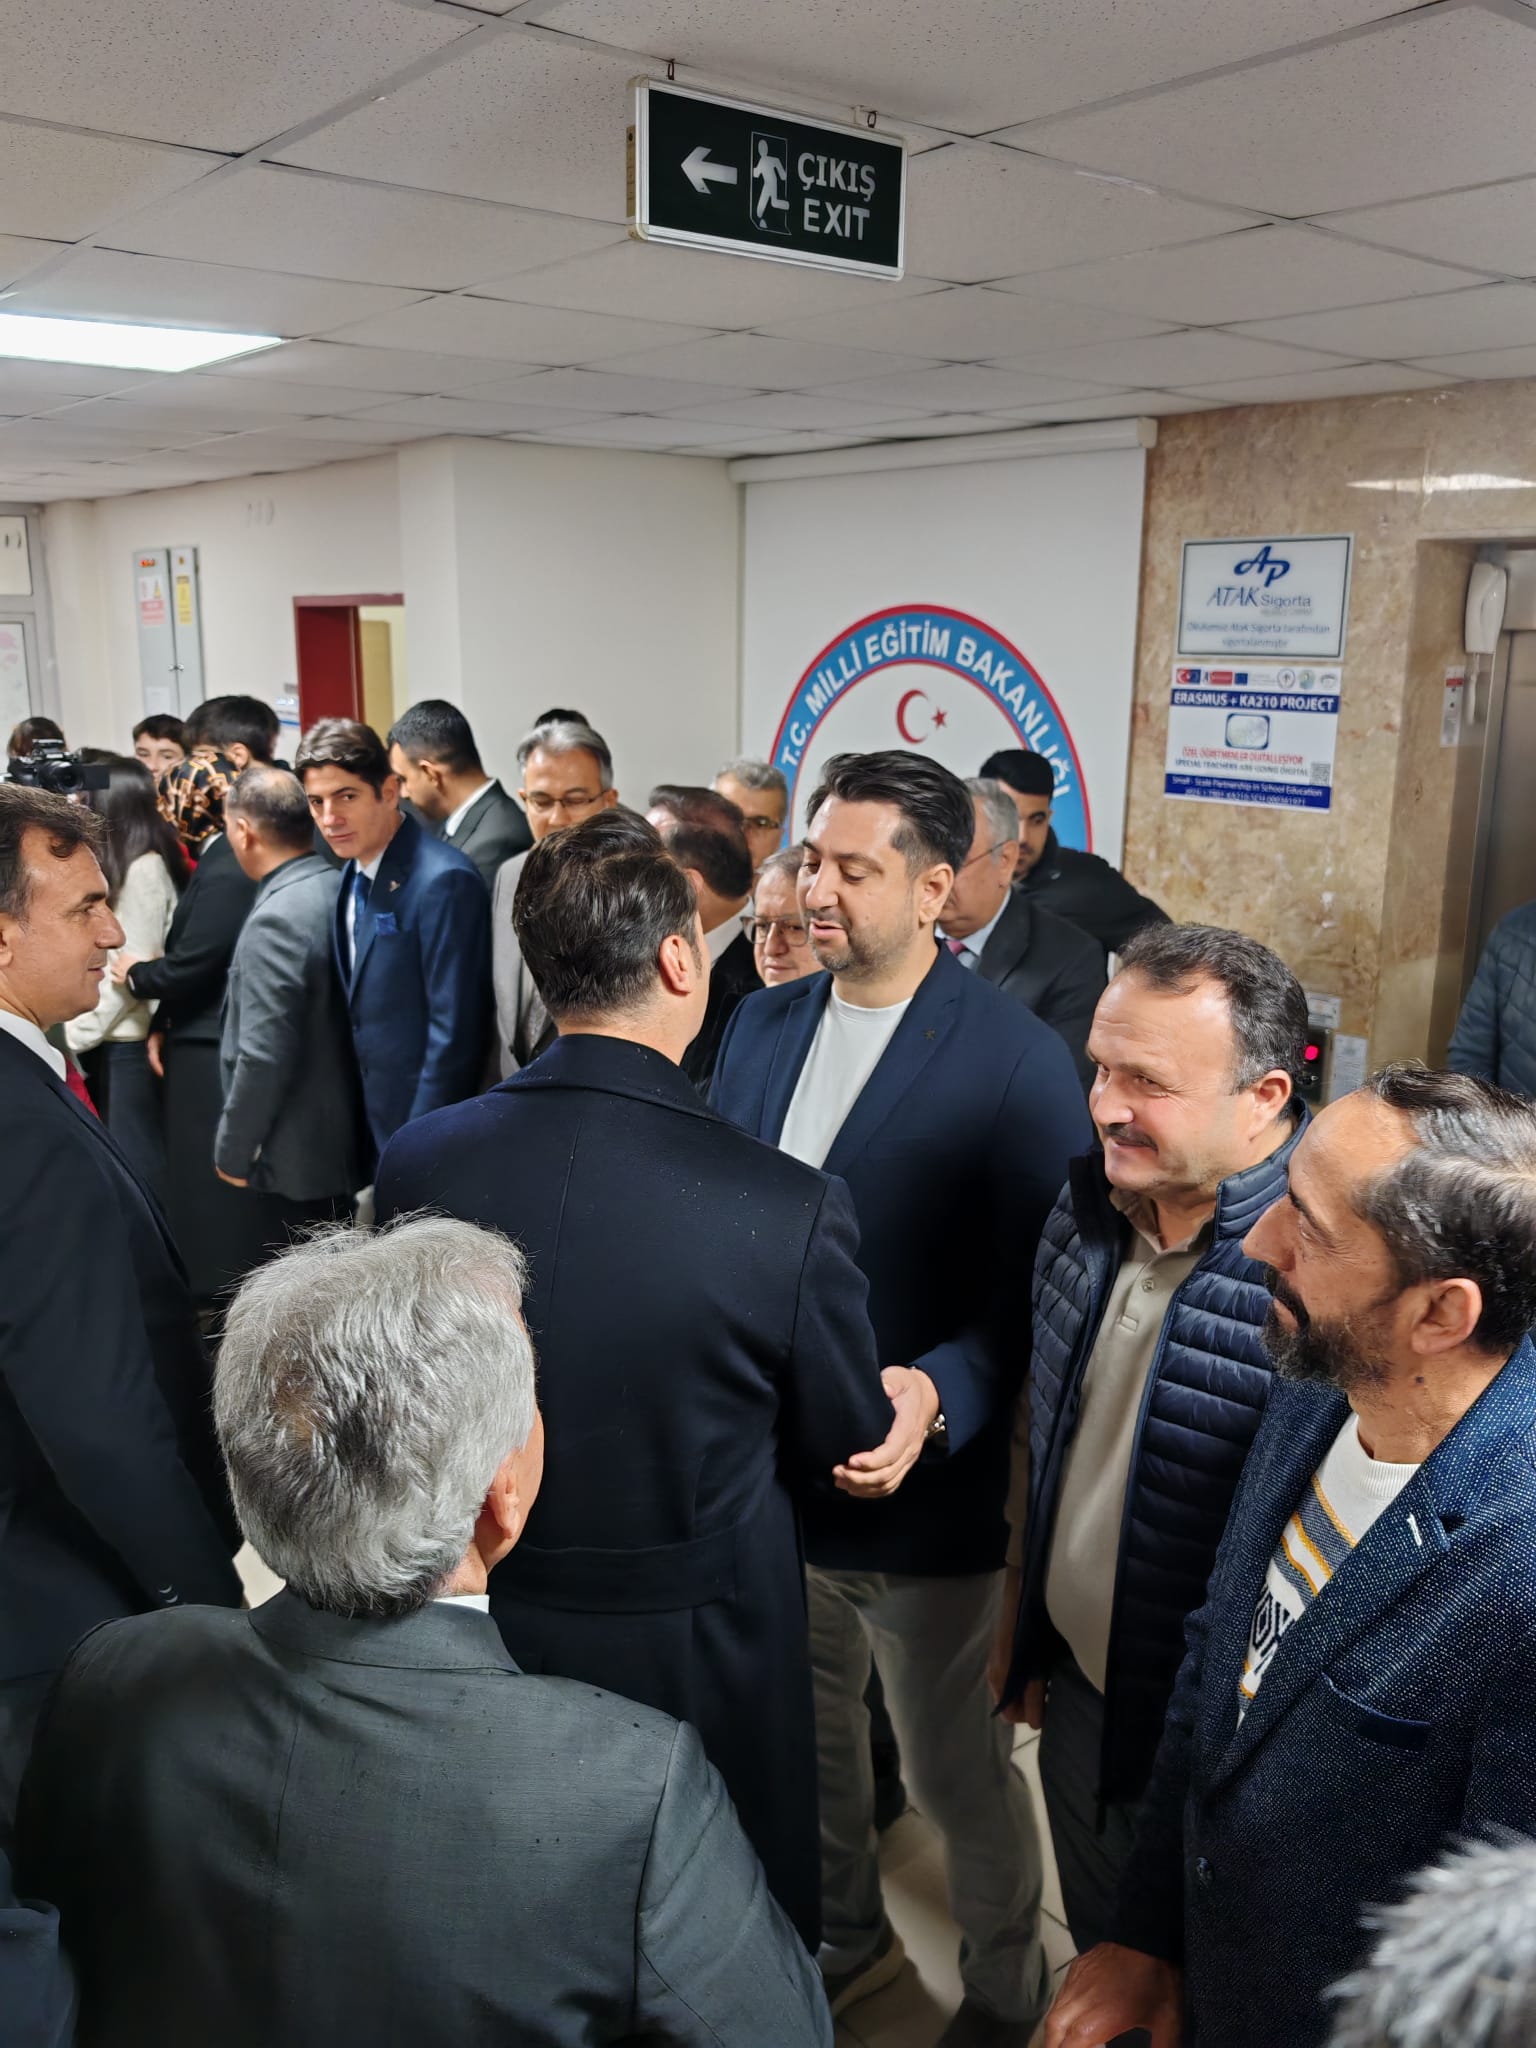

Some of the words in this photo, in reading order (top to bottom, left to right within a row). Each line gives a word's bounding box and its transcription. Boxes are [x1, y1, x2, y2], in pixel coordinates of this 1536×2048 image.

[797, 152, 876, 202] ÇIKIŞ
[803, 198, 870, 240] EXIT
[1206, 586, 1260, 607] ATAK
[1260, 594, 1311, 609] Sigorta
[781, 721, 812, 767] T.C.
[804, 640, 863, 717] MİLLİ
[864, 620, 951, 666] EĞİTİM
[955, 636, 1071, 798] BAKANLIĞI
[1174, 692, 1228, 706] ERASMUS
[1239, 695, 1278, 709] KA210
[1280, 697, 1335, 711] PROJECT
[1286, 785, 1322, 796] Education
